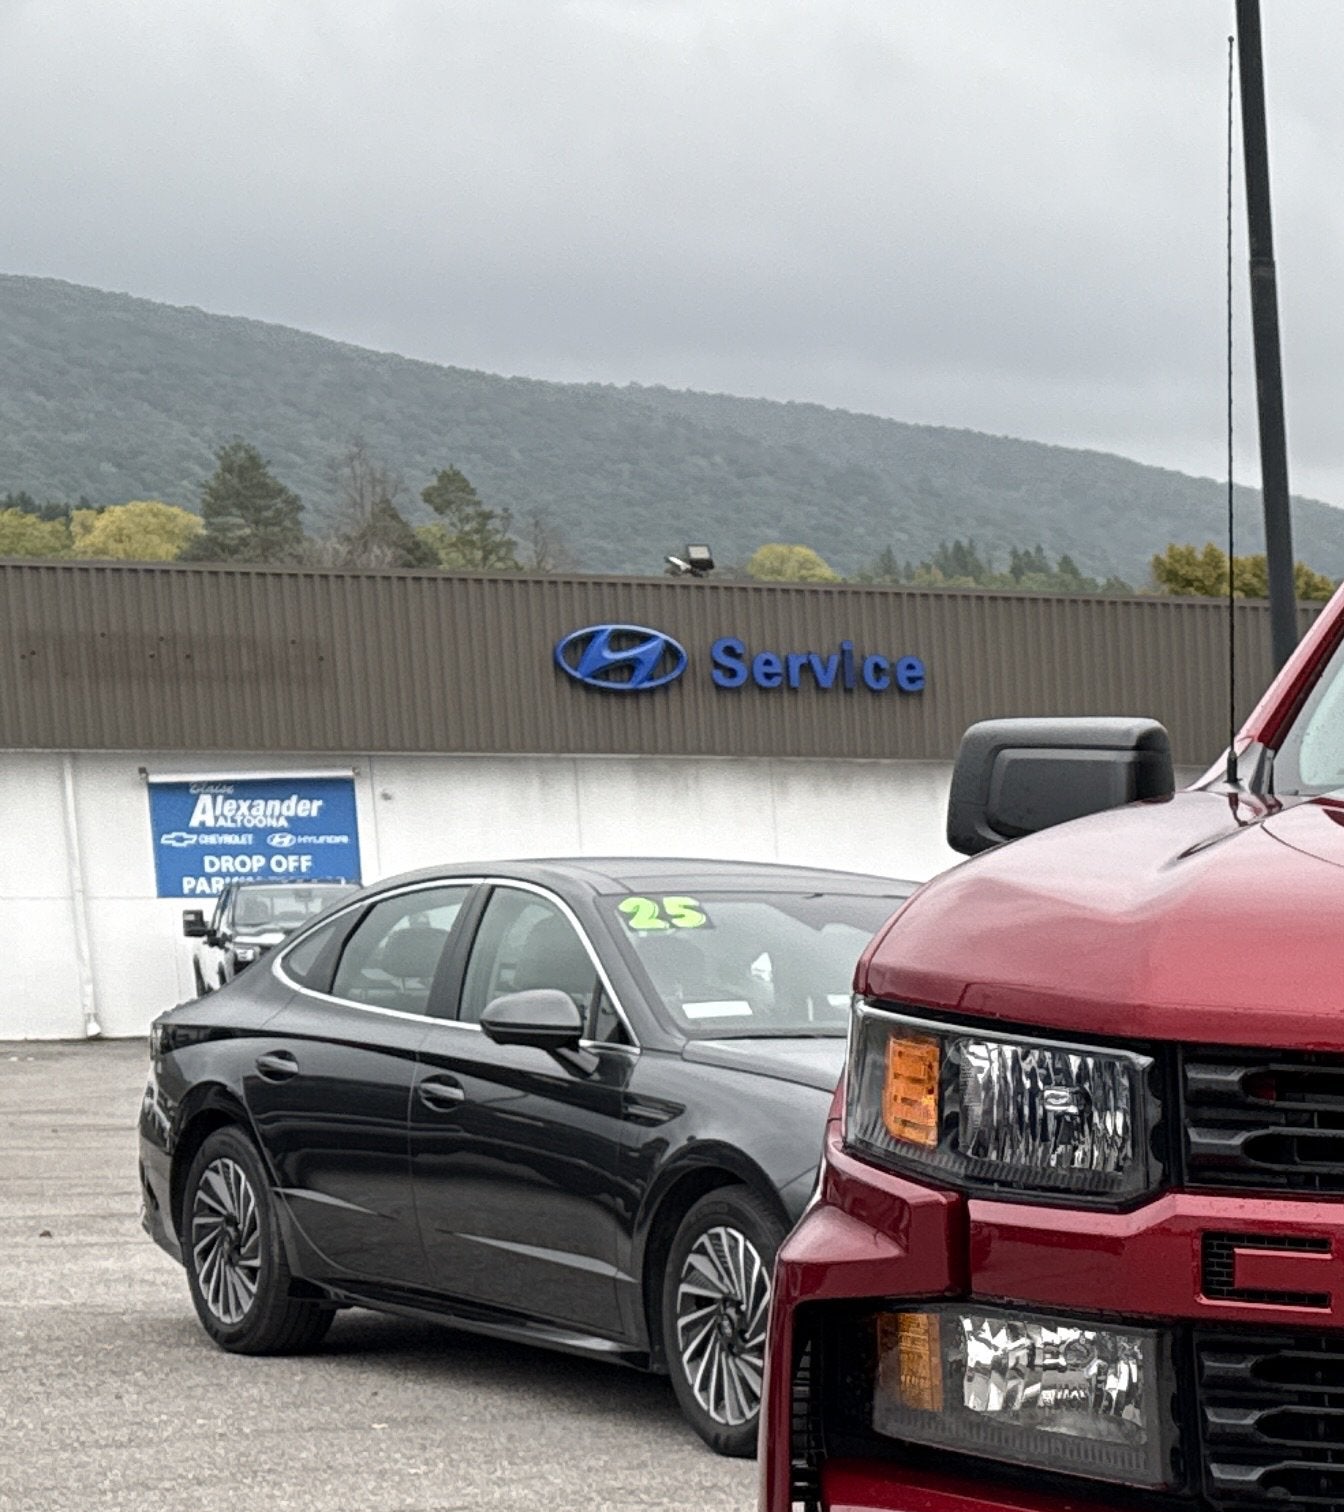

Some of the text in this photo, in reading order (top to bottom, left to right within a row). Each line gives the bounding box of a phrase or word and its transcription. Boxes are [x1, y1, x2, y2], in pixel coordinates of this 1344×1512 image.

[711, 637, 925, 691] Service
[188, 793, 323, 828] Alexander
[215, 815, 289, 828] ALTOONA
[199, 834, 253, 845] CHEVROLET
[203, 855, 312, 873] DROP OFF
[618, 896, 706, 930] 25
